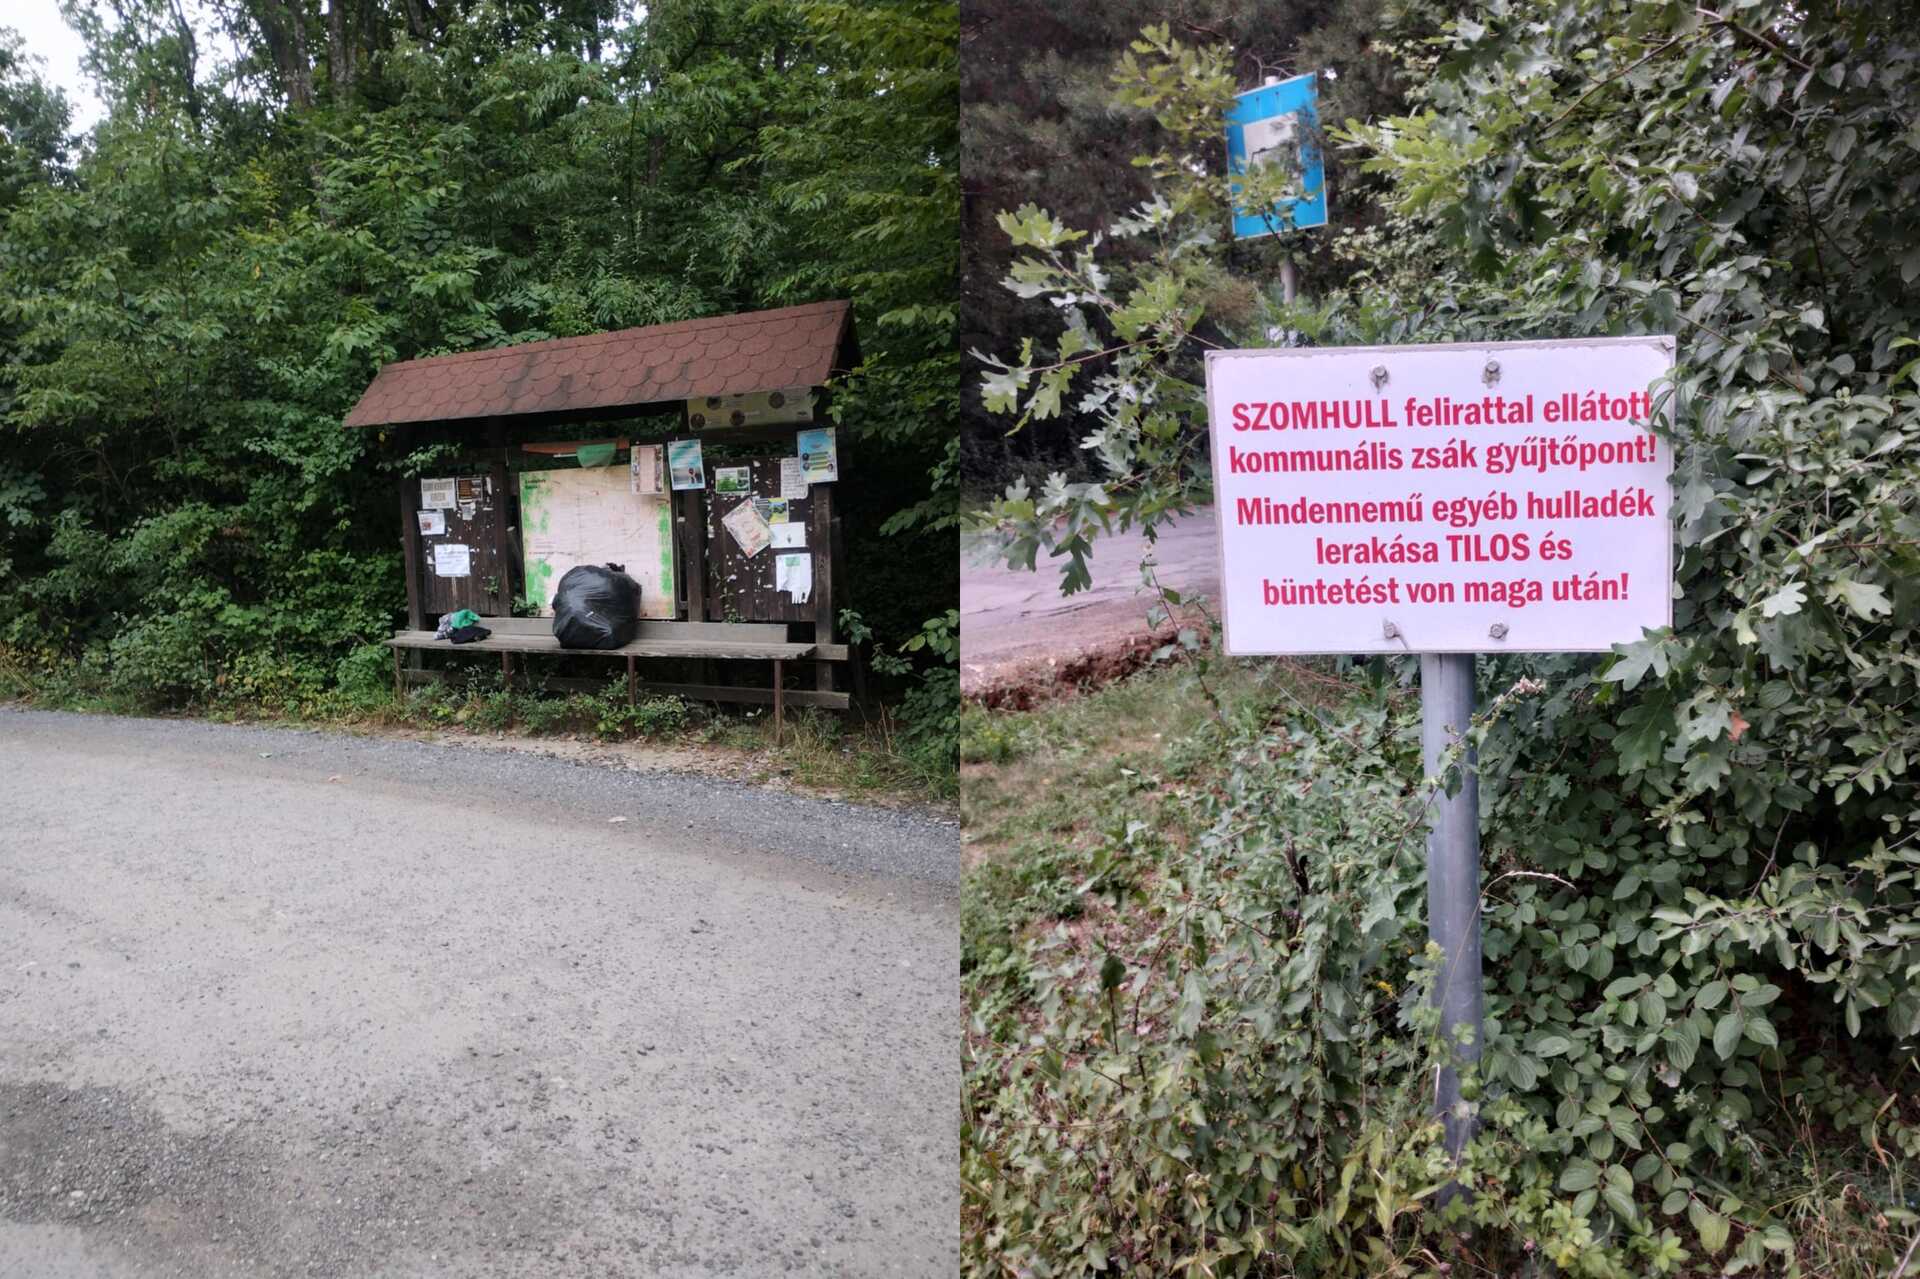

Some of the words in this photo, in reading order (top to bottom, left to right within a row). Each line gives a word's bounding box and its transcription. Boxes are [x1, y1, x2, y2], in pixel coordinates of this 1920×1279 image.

[1231, 399, 1398, 433] SZOMHULL
[1404, 394, 1535, 429] felirattal
[1542, 390, 1654, 424] ellátott
[1229, 438, 1404, 474] kommunális
[1411, 437, 1478, 471] zsák
[1484, 434, 1657, 476] gyűjtőpont!
[1236, 492, 1424, 527] Mindennemű
[1431, 490, 1519, 529] egyéb
[1526, 486, 1656, 520] hulladék
[1315, 532, 1440, 566] lerakása
[1445, 532, 1531, 564] TILOS
[1538, 530, 1574, 562] és
[1263, 574, 1400, 607] büntetést
[1406, 582, 1456, 605] von
[1463, 579, 1543, 609] maga
[1551, 571, 1629, 603] után!
